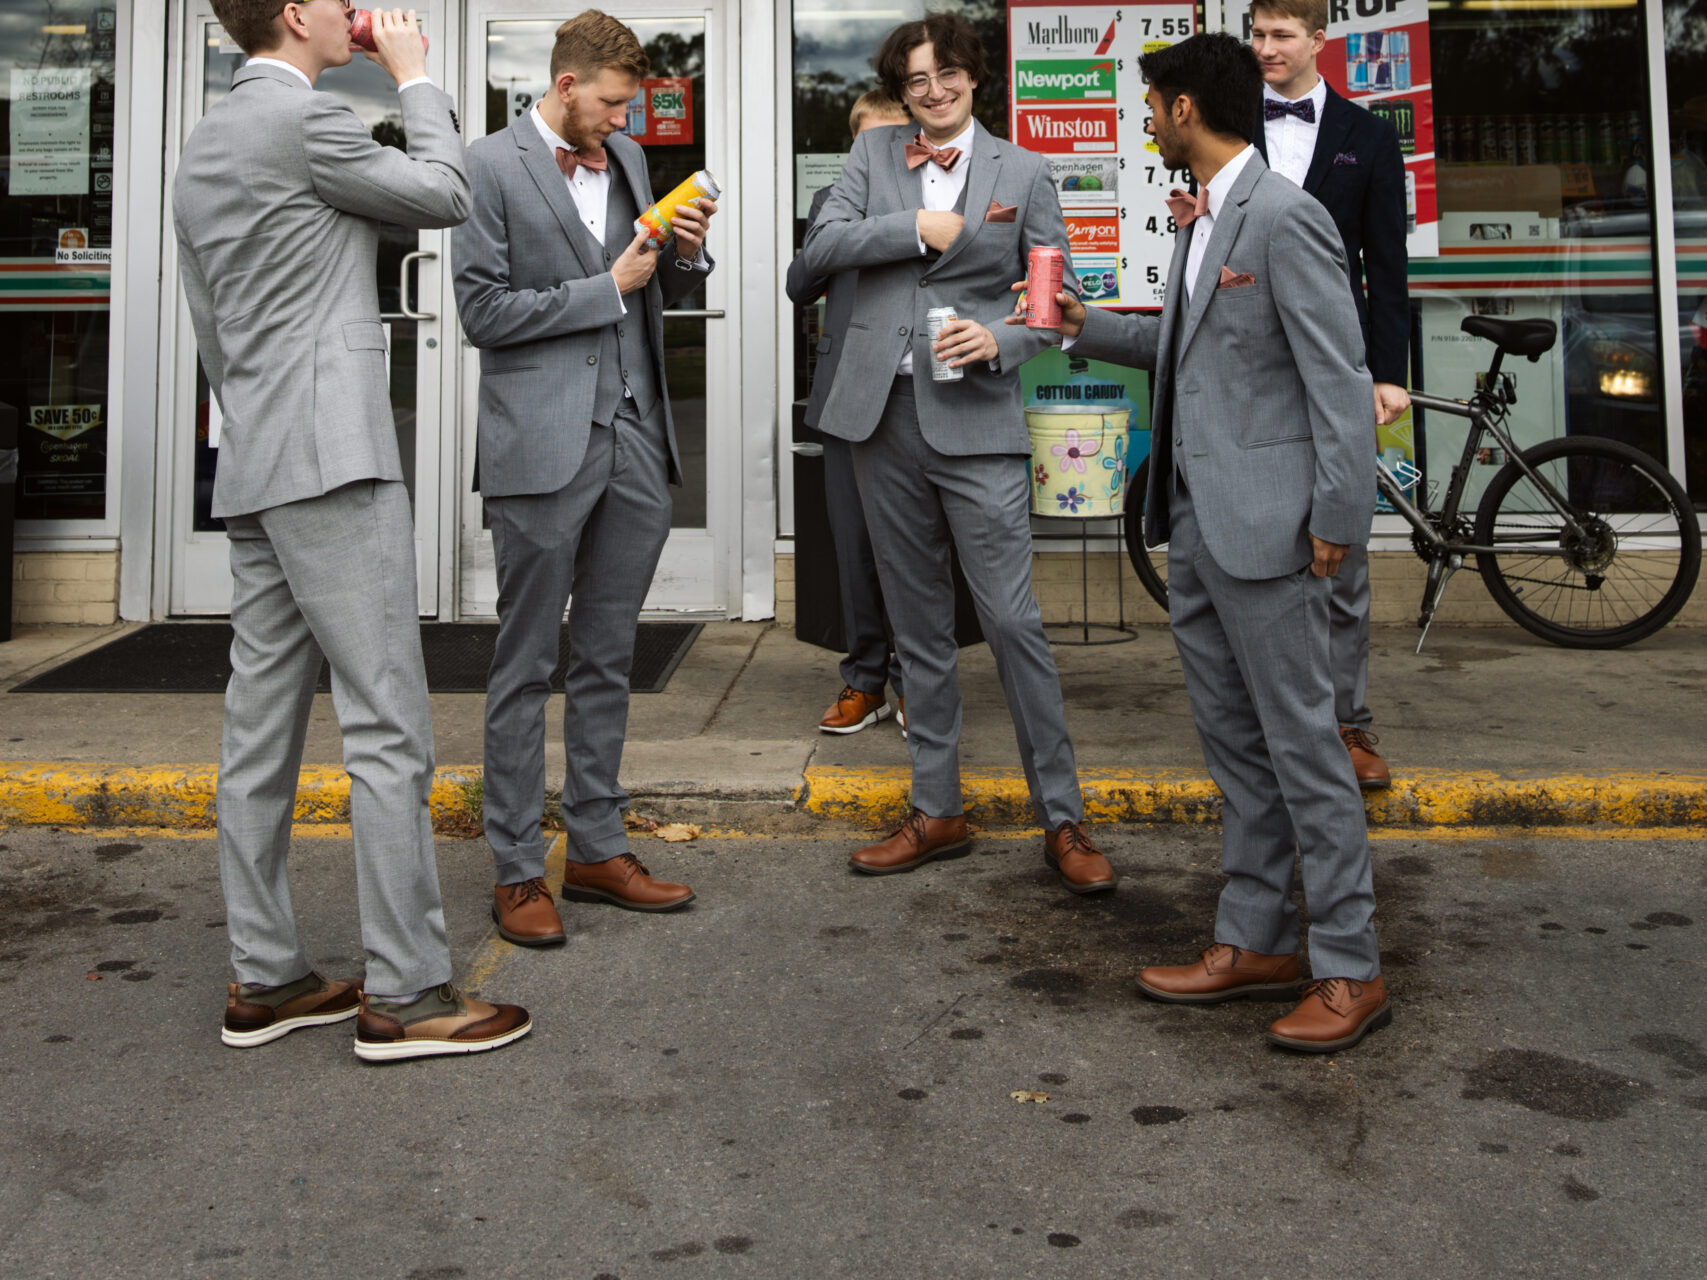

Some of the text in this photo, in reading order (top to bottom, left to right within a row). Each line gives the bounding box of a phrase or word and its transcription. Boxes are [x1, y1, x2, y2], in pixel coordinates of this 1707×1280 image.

[1028, 15, 1099, 45] Marlboro
[1141, 18, 1190, 39] 7.55
[1018, 70, 1100, 90] Newport
[19, 91, 81, 101] RESTROOMS
[652, 93, 684, 110] $5K
[1026, 114, 1108, 138] Winston
[1145, 216, 1178, 236] 4.8
[57, 251, 69, 260] No
[1036, 384, 1125, 400] COTTON CANDY
[34, 408, 69, 425] SAVE
